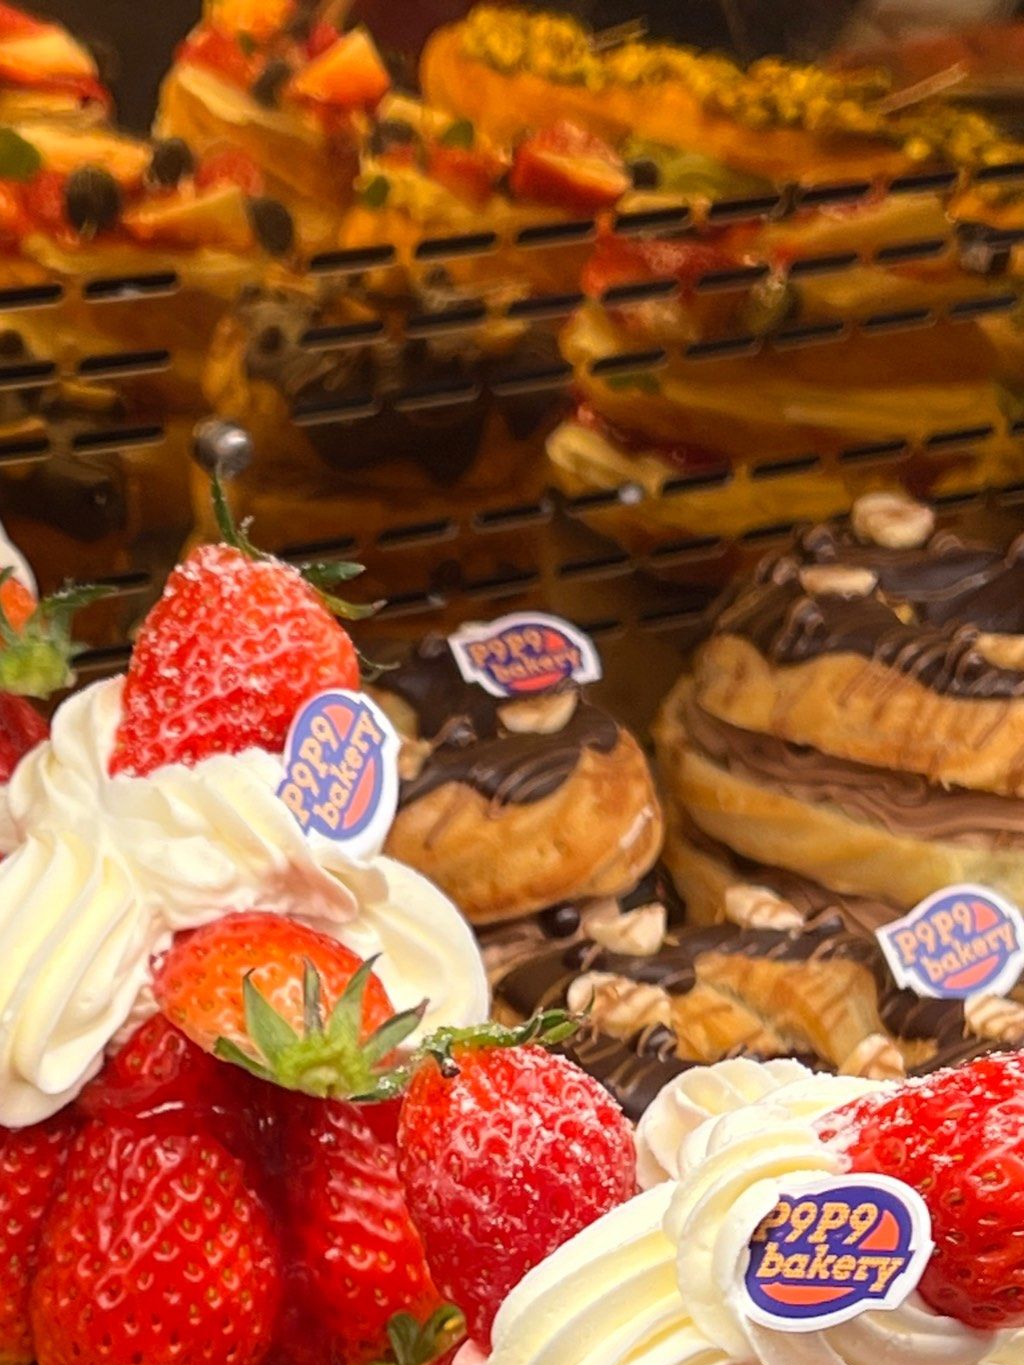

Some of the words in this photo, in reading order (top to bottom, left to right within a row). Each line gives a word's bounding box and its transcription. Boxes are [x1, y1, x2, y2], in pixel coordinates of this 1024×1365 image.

[487, 647, 581, 684] bakery
[312, 710, 382, 830] bakery
[919, 922, 1017, 983] bakery
[755, 1242, 906, 1293] bakery
